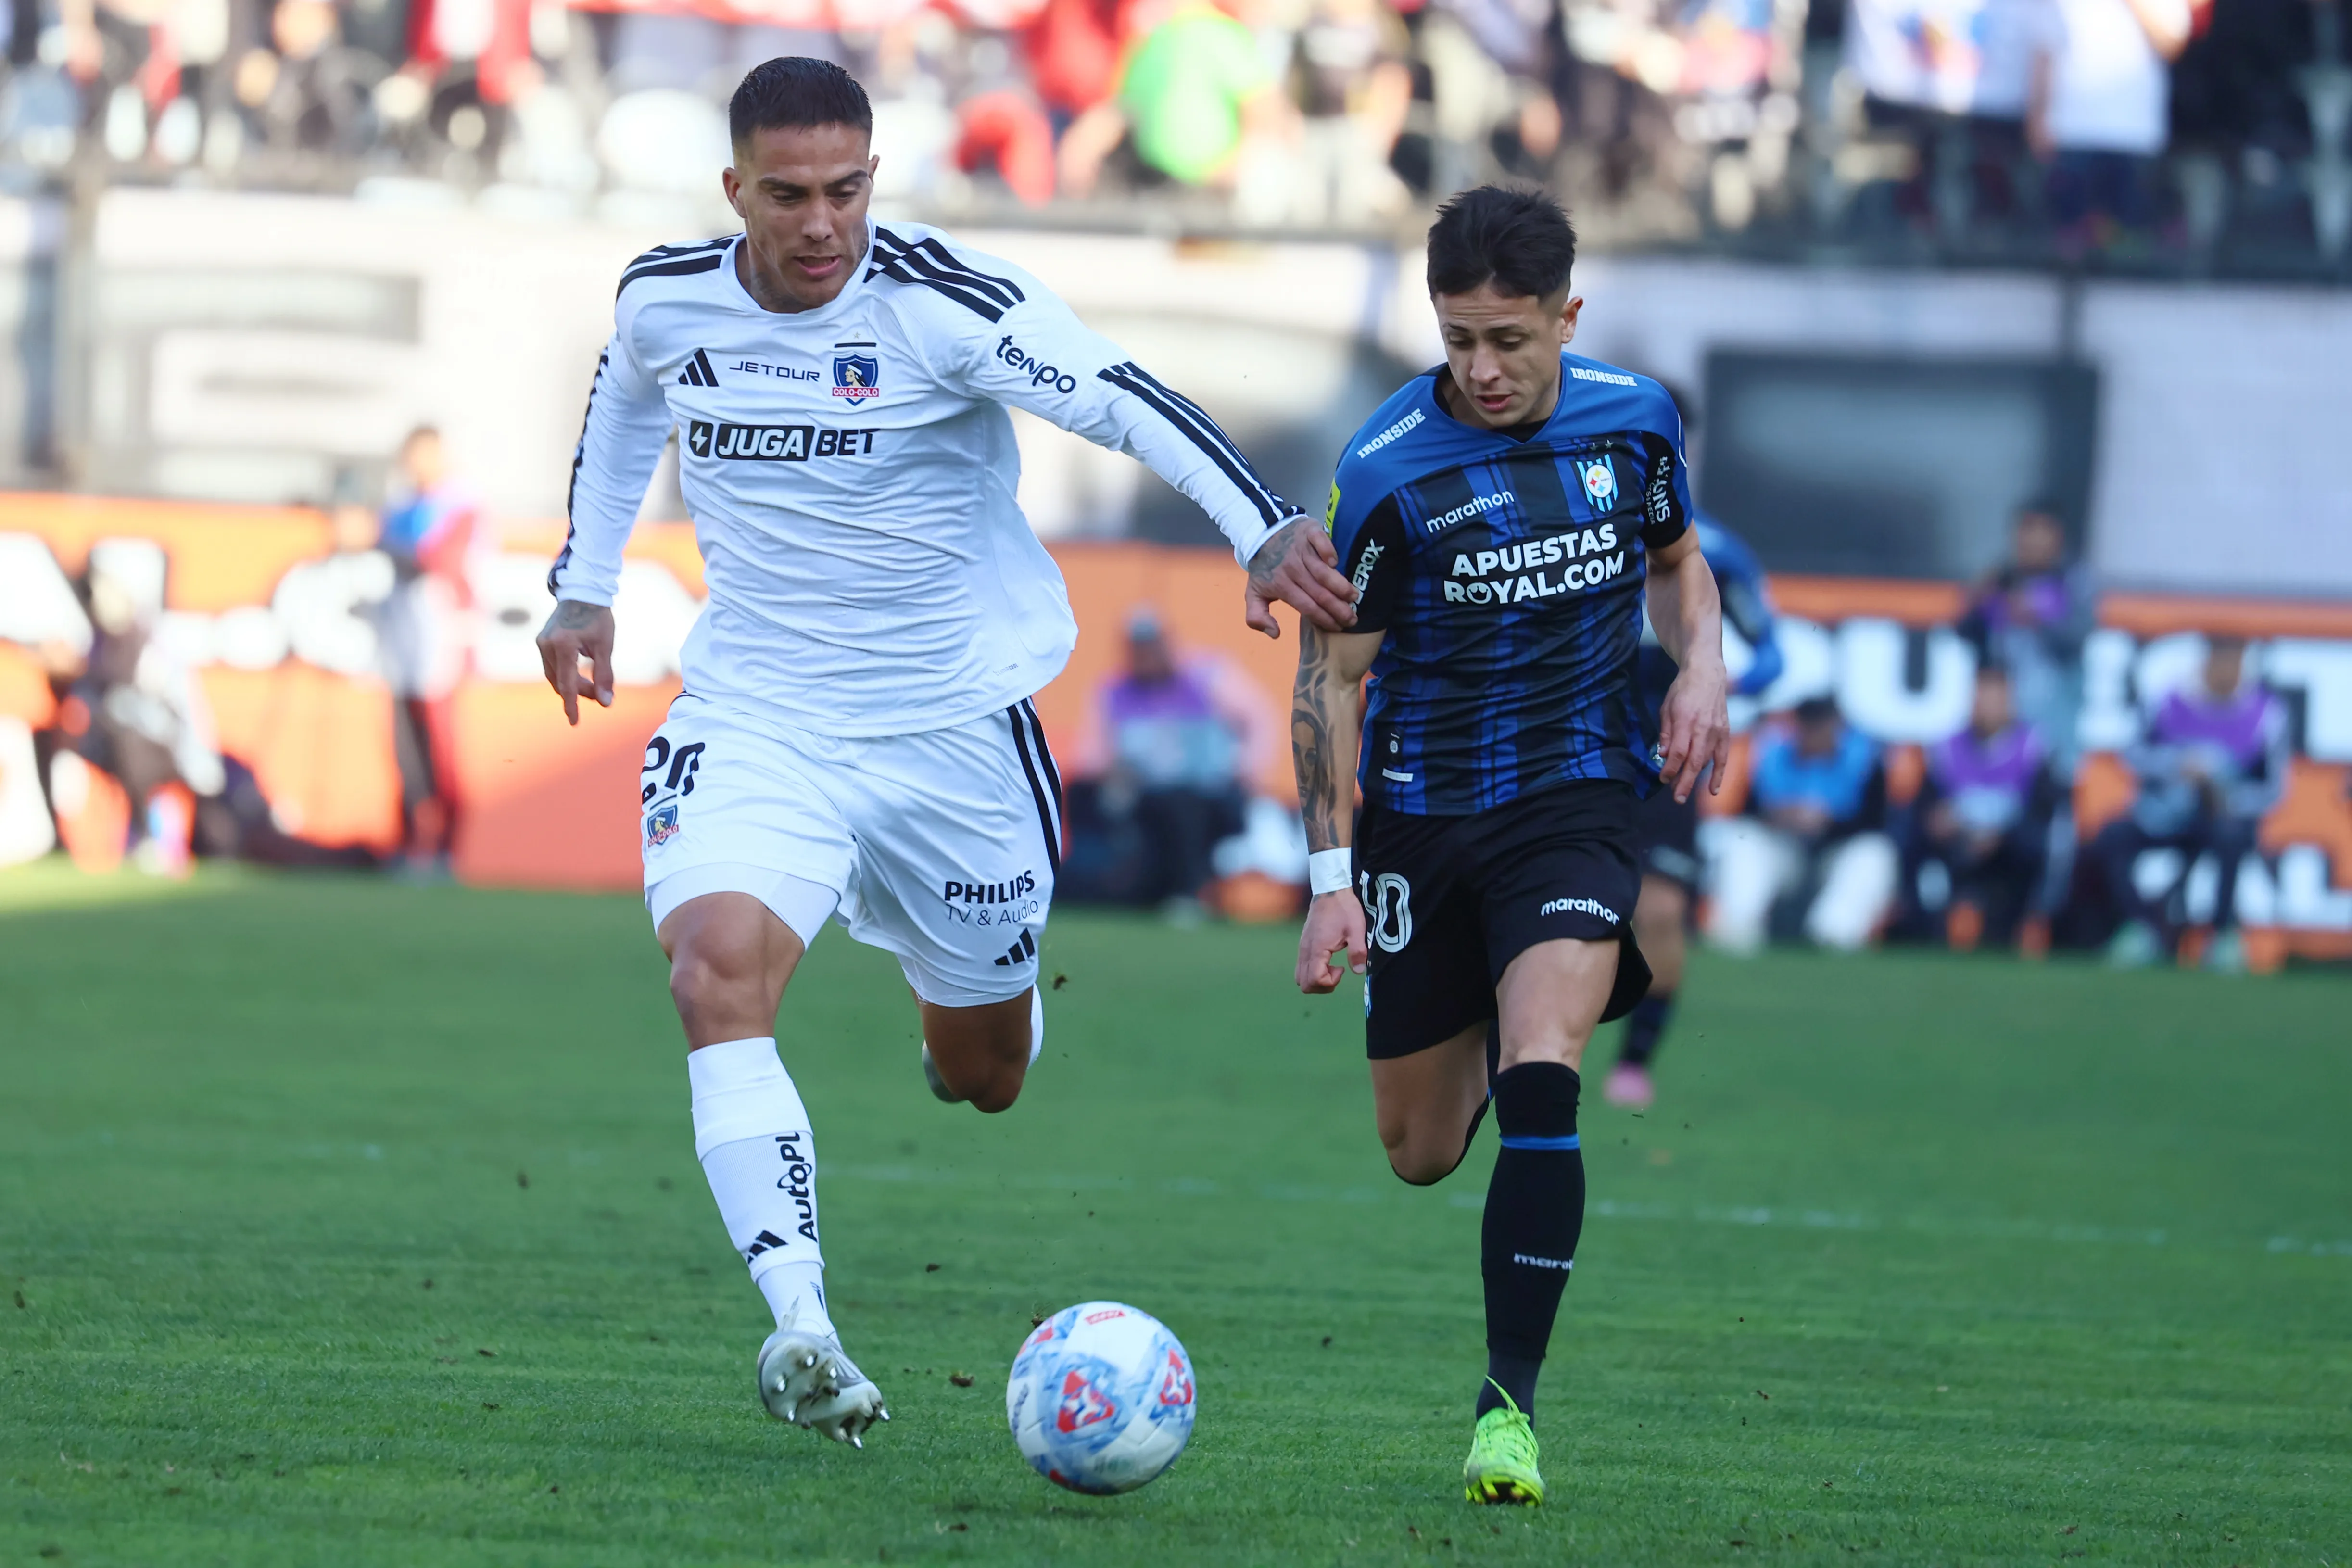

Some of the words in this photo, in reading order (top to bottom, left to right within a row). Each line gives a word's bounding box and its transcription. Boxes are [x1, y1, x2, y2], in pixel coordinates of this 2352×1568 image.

[729, 361, 820, 382] JETOUR
[1570, 367, 1638, 387] IRONSIDE
[833, 387, 879, 397] COLO-COLO
[1357, 408, 1426, 459] IRONSIDE
[1426, 491, 1515, 533] marathon
[1452, 523, 1617, 577] APUESTAS
[1444, 550, 1625, 605] ROYAL.COM
[945, 870, 1035, 903] PHILIPS
[946, 903, 971, 923] TV
[977, 910, 991, 926] &
[998, 899, 1038, 926] Audio
